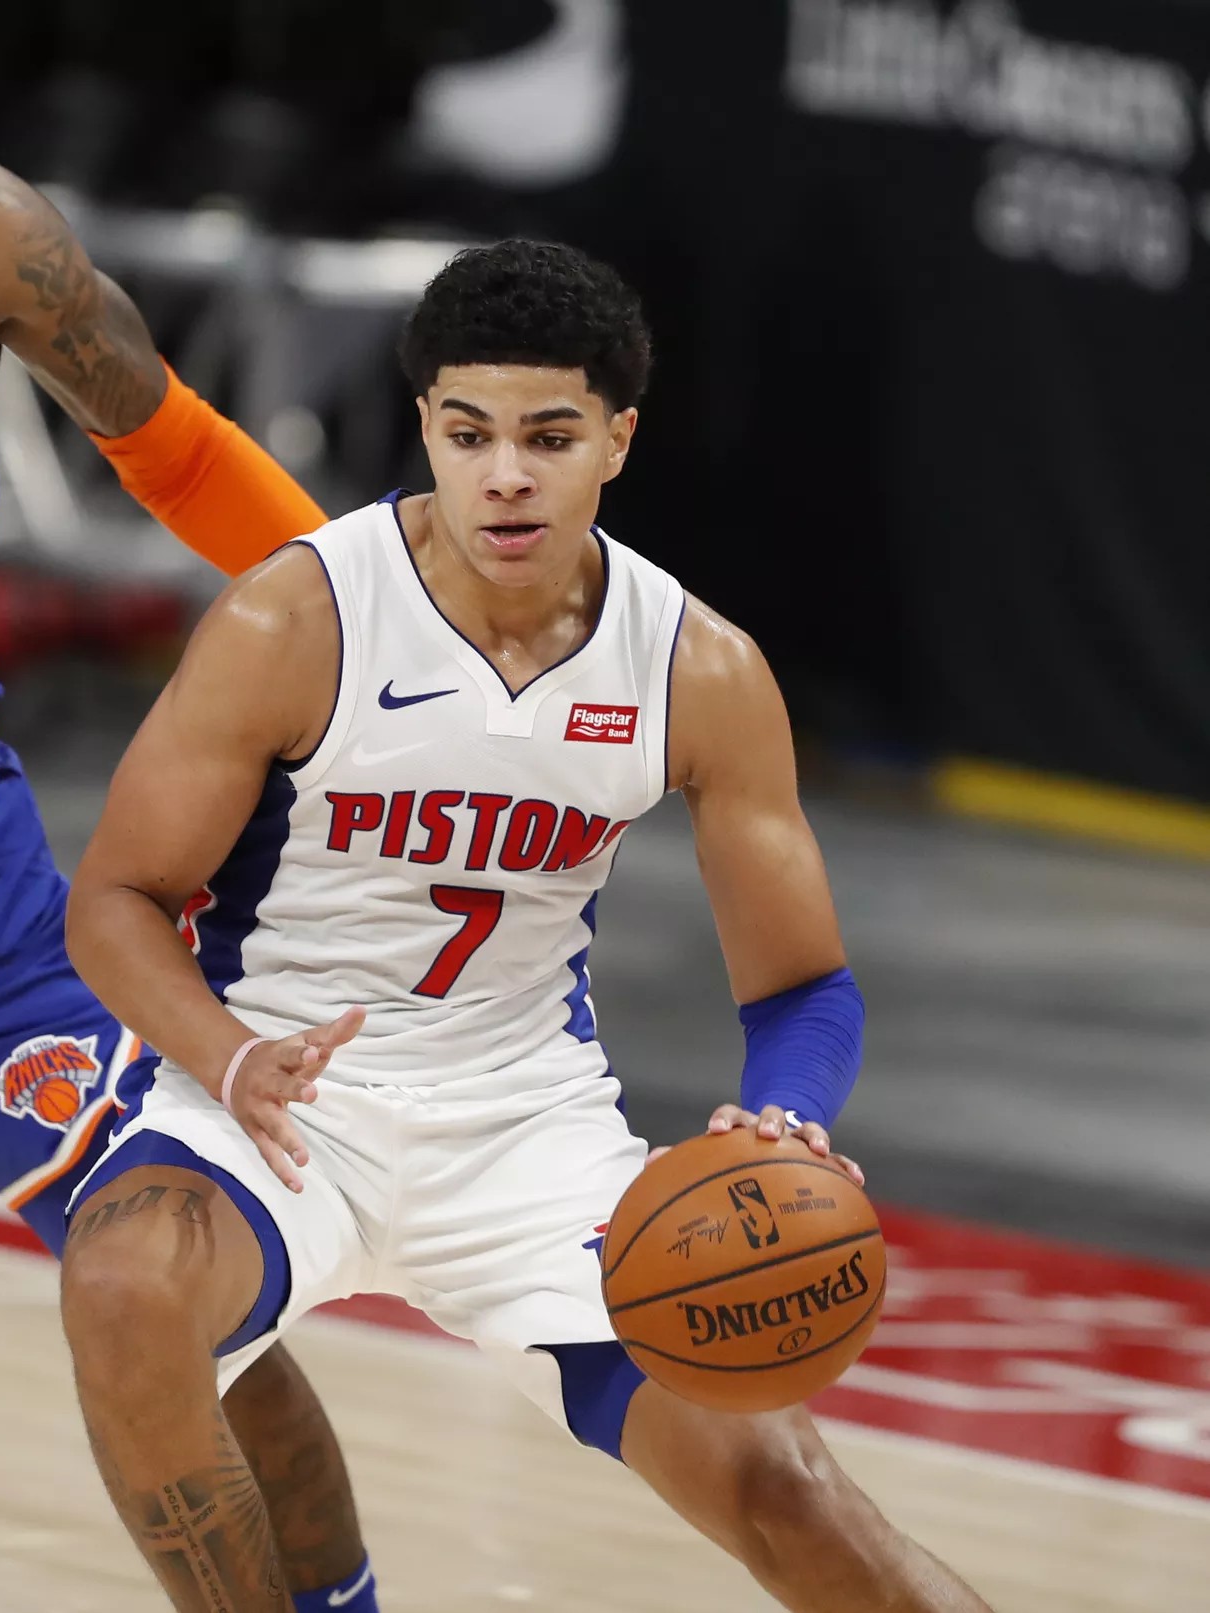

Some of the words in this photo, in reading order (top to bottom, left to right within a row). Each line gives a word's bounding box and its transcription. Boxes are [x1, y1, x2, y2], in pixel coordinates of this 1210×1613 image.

[572, 709, 632, 727] Flagstar
[608, 728, 629, 738] Bank
[410, 884, 504, 999] 7
[5, 1042, 97, 1108] KNICKS
[738, 1180, 758, 1194] NBA
[684, 1250, 869, 1347] SPALDING
